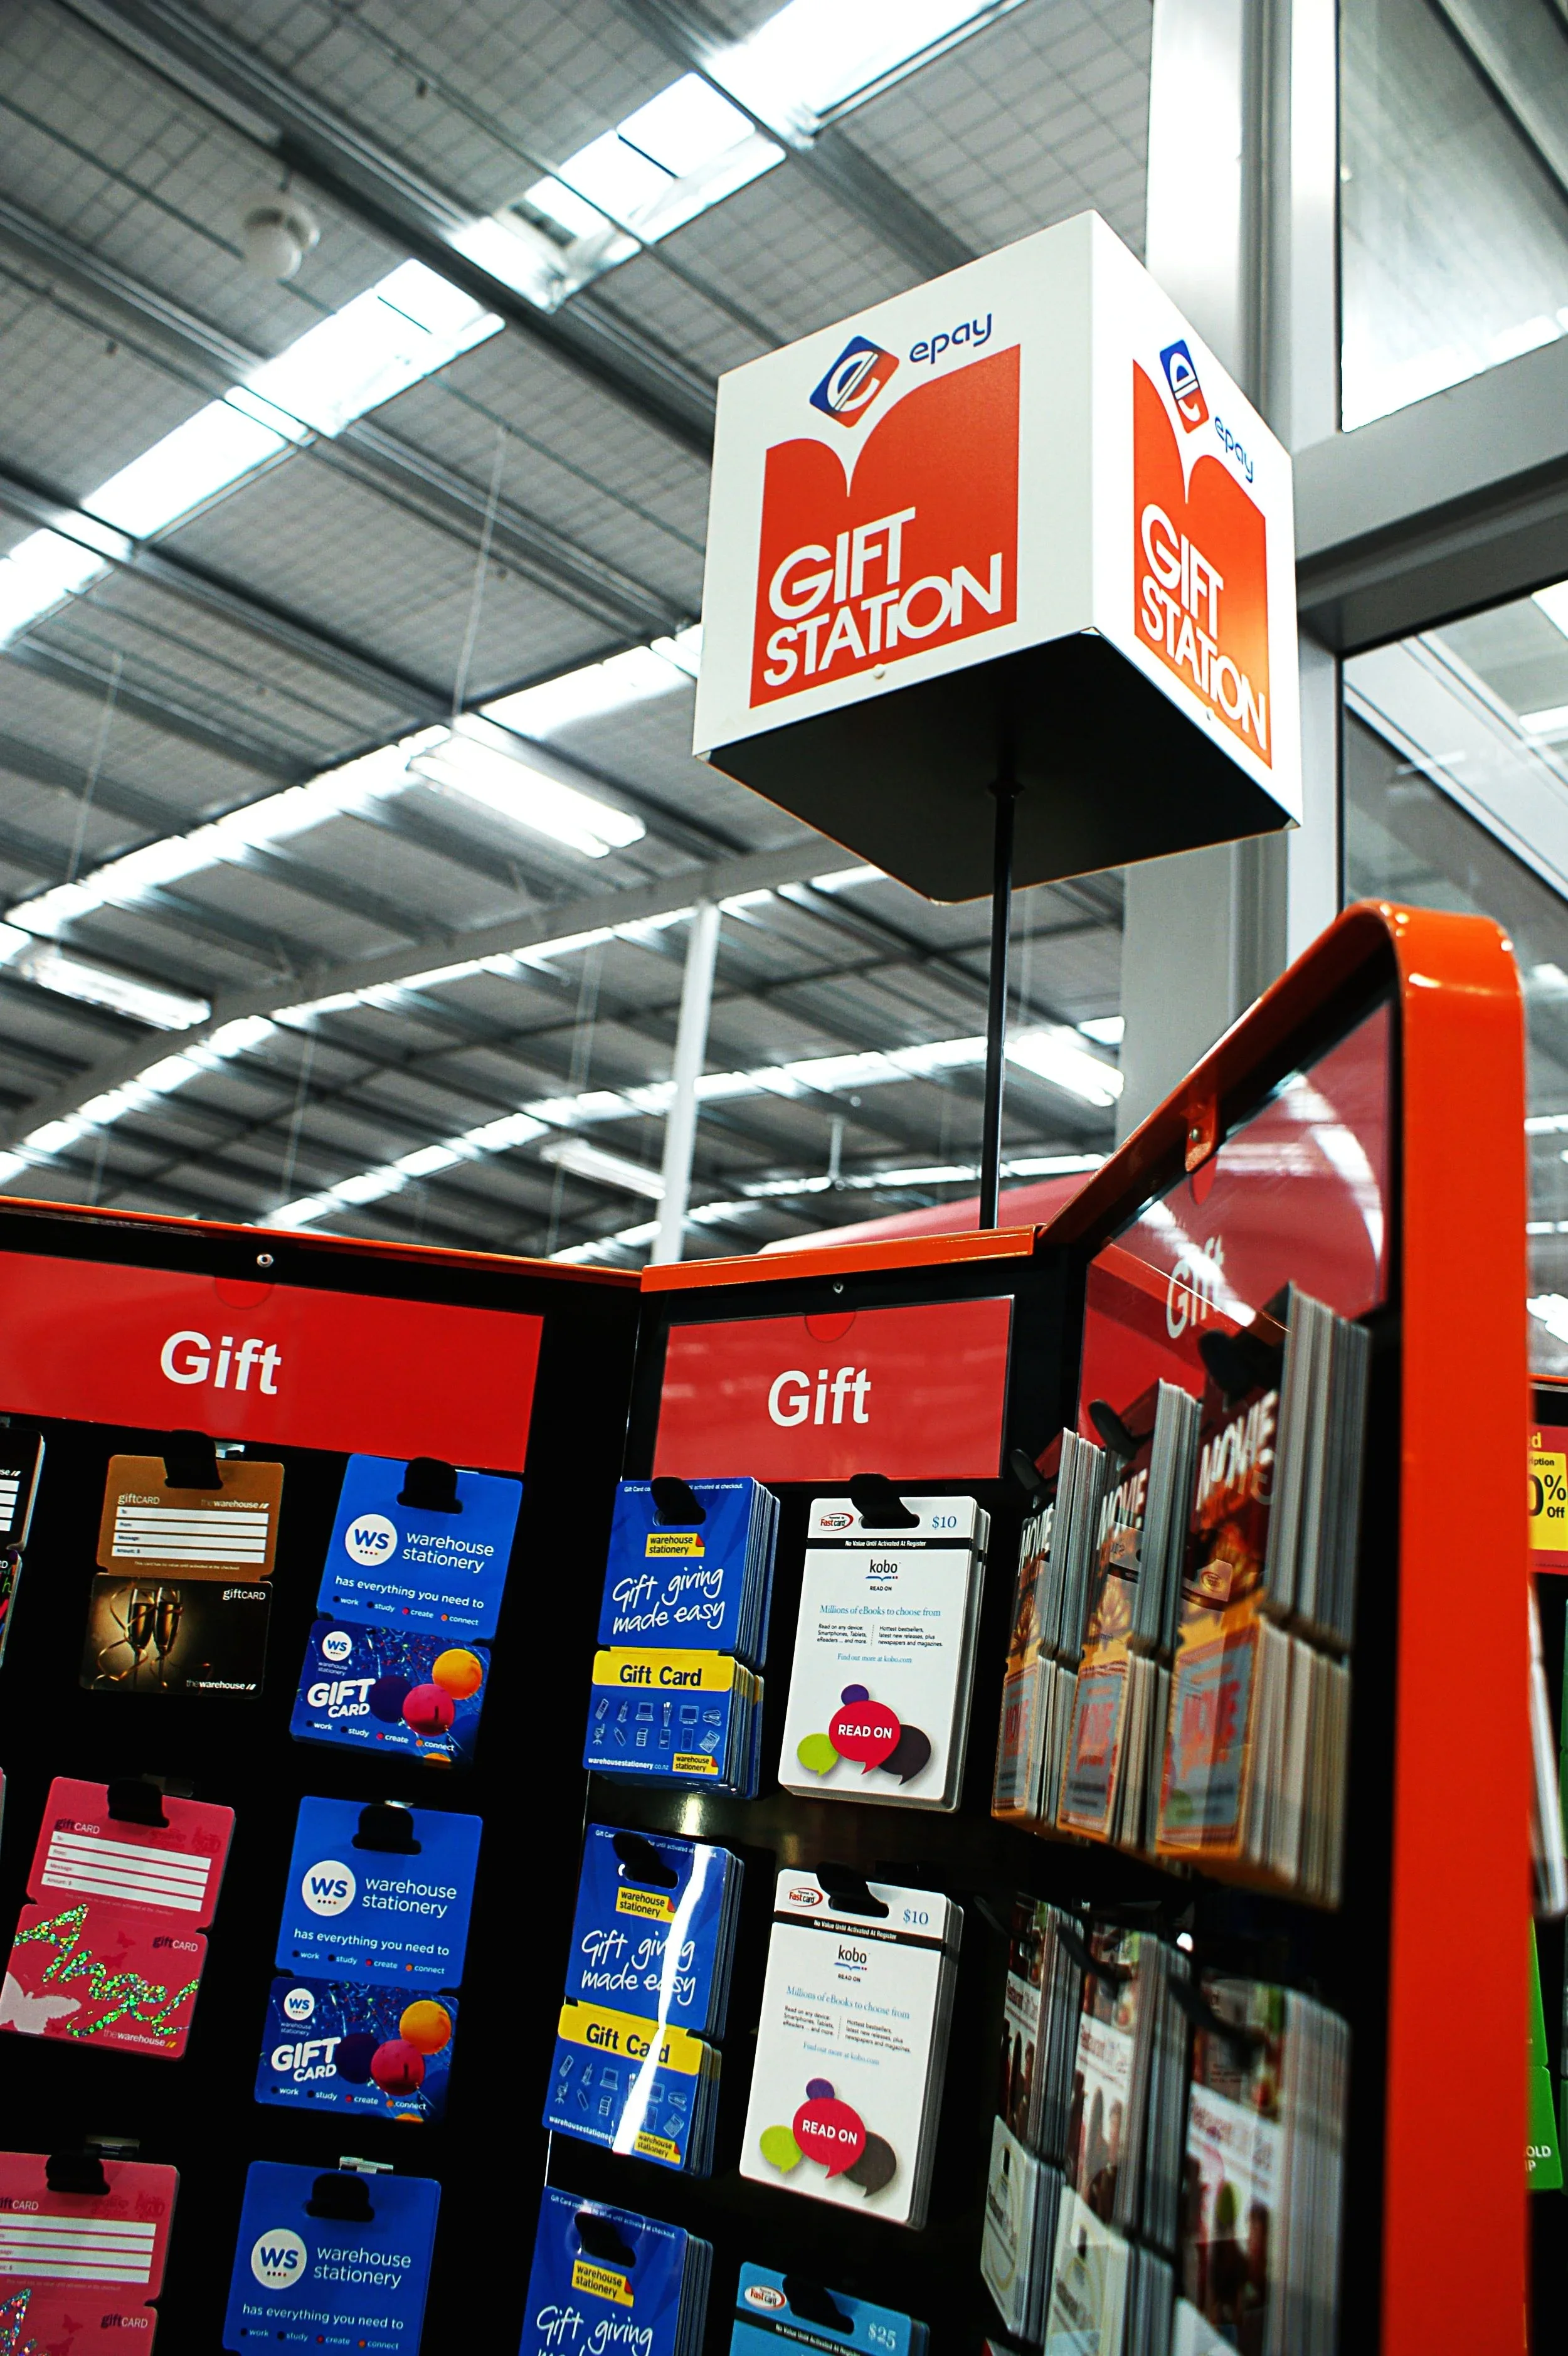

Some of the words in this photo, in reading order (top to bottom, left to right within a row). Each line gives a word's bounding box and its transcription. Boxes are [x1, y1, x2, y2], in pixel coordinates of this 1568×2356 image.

[909, 313, 992, 364] epay
[1214, 415, 1253, 483] epay
[768, 506, 915, 620] GIFT
[1141, 504, 1223, 639] GIFT
[763, 552, 1002, 687] STATION
[1142, 575, 1266, 750] STATION
[159, 1330, 282, 1396] Gift
[767, 1367, 871, 1426] Gift
[932, 1515, 956, 1529] $10
[1547, 1507, 1565, 1518] Off
[354, 1528, 389, 1549] WS
[407, 1532, 494, 1557] warehouse
[649, 1546, 689, 1555] stationery
[402, 1547, 484, 1574] stationery
[870, 1559, 898, 1573] kobo
[223, 1588, 265, 1600] giftCARD
[335, 1576, 354, 1587] has
[358, 1579, 415, 1599] everything
[418, 1590, 438, 1602] you
[442, 1595, 469, 1606] need
[472, 1599, 484, 1608] to
[612, 1574, 659, 1612] Gift
[662, 1566, 724, 1606] giving
[341, 1597, 359, 1606] work
[374, 1603, 395, 1613] study
[410, 1608, 433, 1618] create
[449, 1615, 479, 1625] connect
[613, 1605, 669, 1635] made
[674, 1600, 726, 1629] easy
[820, 1605, 849, 1614] Millions
[850, 1605, 859, 1614] of
[859, 1606, 884, 1615] eBooks
[896, 1607, 921, 1616] choose
[923, 1607, 941, 1616] from
[327, 1639, 347, 1652] WS
[619, 1664, 652, 1684] Gift
[659, 1667, 702, 1687] Card
[307, 1678, 376, 1707] GIFT
[328, 1703, 370, 1718] CARD
[314, 1722, 332, 1731] work
[348, 1727, 369, 1738] study
[385, 1734, 408, 1744] create
[425, 1740, 455, 1751] connect
[837, 1724, 871, 1738] READ
[874, 1726, 893, 1739] ON
[588, 1757, 669, 1770] warehousestationery.co.nz
[675, 1763, 706, 1772] stationery
[310, 1876, 347, 1898] WS
[366, 1876, 457, 1900] warehouse
[621, 1891, 665, 1906] warehouse
[363, 1895, 448, 1918] stationery
[620, 1901, 660, 1918] stationery
[903, 1908, 928, 1924] $10
[294, 1929, 314, 1941] has
[317, 1933, 378, 1949] everything
[381, 1939, 401, 1951] you
[405, 1943, 433, 1954] need
[437, 1946, 449, 1956] to
[581, 1929, 628, 1966] Gift
[838, 1945, 867, 1963] kobo
[300, 1951, 320, 1959] work
[336, 1955, 358, 1965] study
[374, 1960, 398, 1969] create
[414, 1964, 445, 1975] connect
[581, 1962, 638, 1992] made
[644, 1970, 696, 2006] esy
[289, 1998, 310, 2010] WS
[271, 2037, 341, 2071] GIFT
[586, 2023, 619, 2050] Gift
[626, 2034, 670, 2065] Cad
[293, 2064, 337, 2083] CARD
[279, 2087, 299, 2096] work
[315, 2091, 337, 2102] study
[354, 2095, 379, 2104] create
[395, 2099, 426, 2110] connect
[638, 2134, 672, 2149] warehouse
[802, 2119, 836, 2138] READ
[838, 2128, 857, 2145] ON
[637, 2141, 669, 2158] stationery
[260, 2246, 299, 2269] WS
[317, 2247, 411, 2268] warehouse
[314, 2264, 401, 2290] stationery
[576, 2274, 617, 2299] stationery
[577, 2264, 622, 2288] warehouse
[243, 2303, 263, 2315] has
[267, 2306, 329, 2324] everything
[333, 2314, 354, 2325] you
[358, 2317, 389, 2327] need
[392, 2320, 403, 2330] to
[537, 2305, 585, 2347] Gift
[869, 2322, 896, 2350] $25
